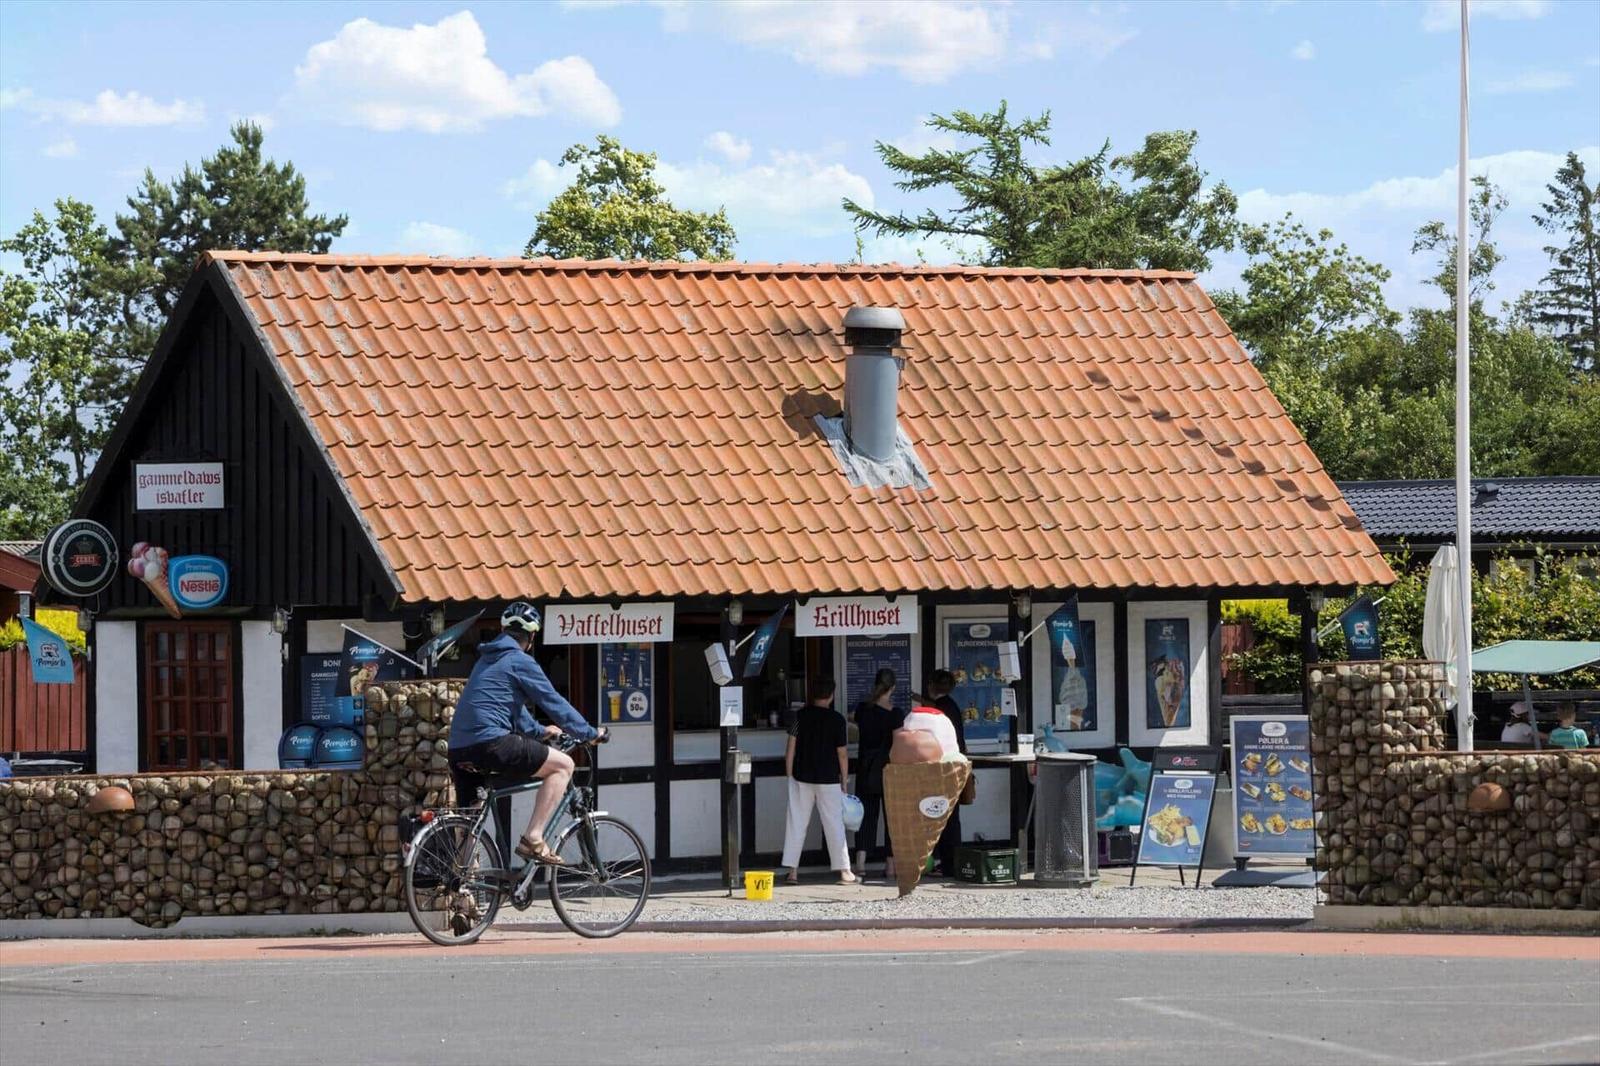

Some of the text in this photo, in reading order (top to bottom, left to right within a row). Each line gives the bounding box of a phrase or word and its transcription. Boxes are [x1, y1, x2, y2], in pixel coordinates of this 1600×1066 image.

[156, 489, 204, 505] isvafler
[558, 613, 662, 638] Vaffelhuset
[814, 604, 900, 629] Grillhuset
[1258, 737, 1284, 745] PØLSER
